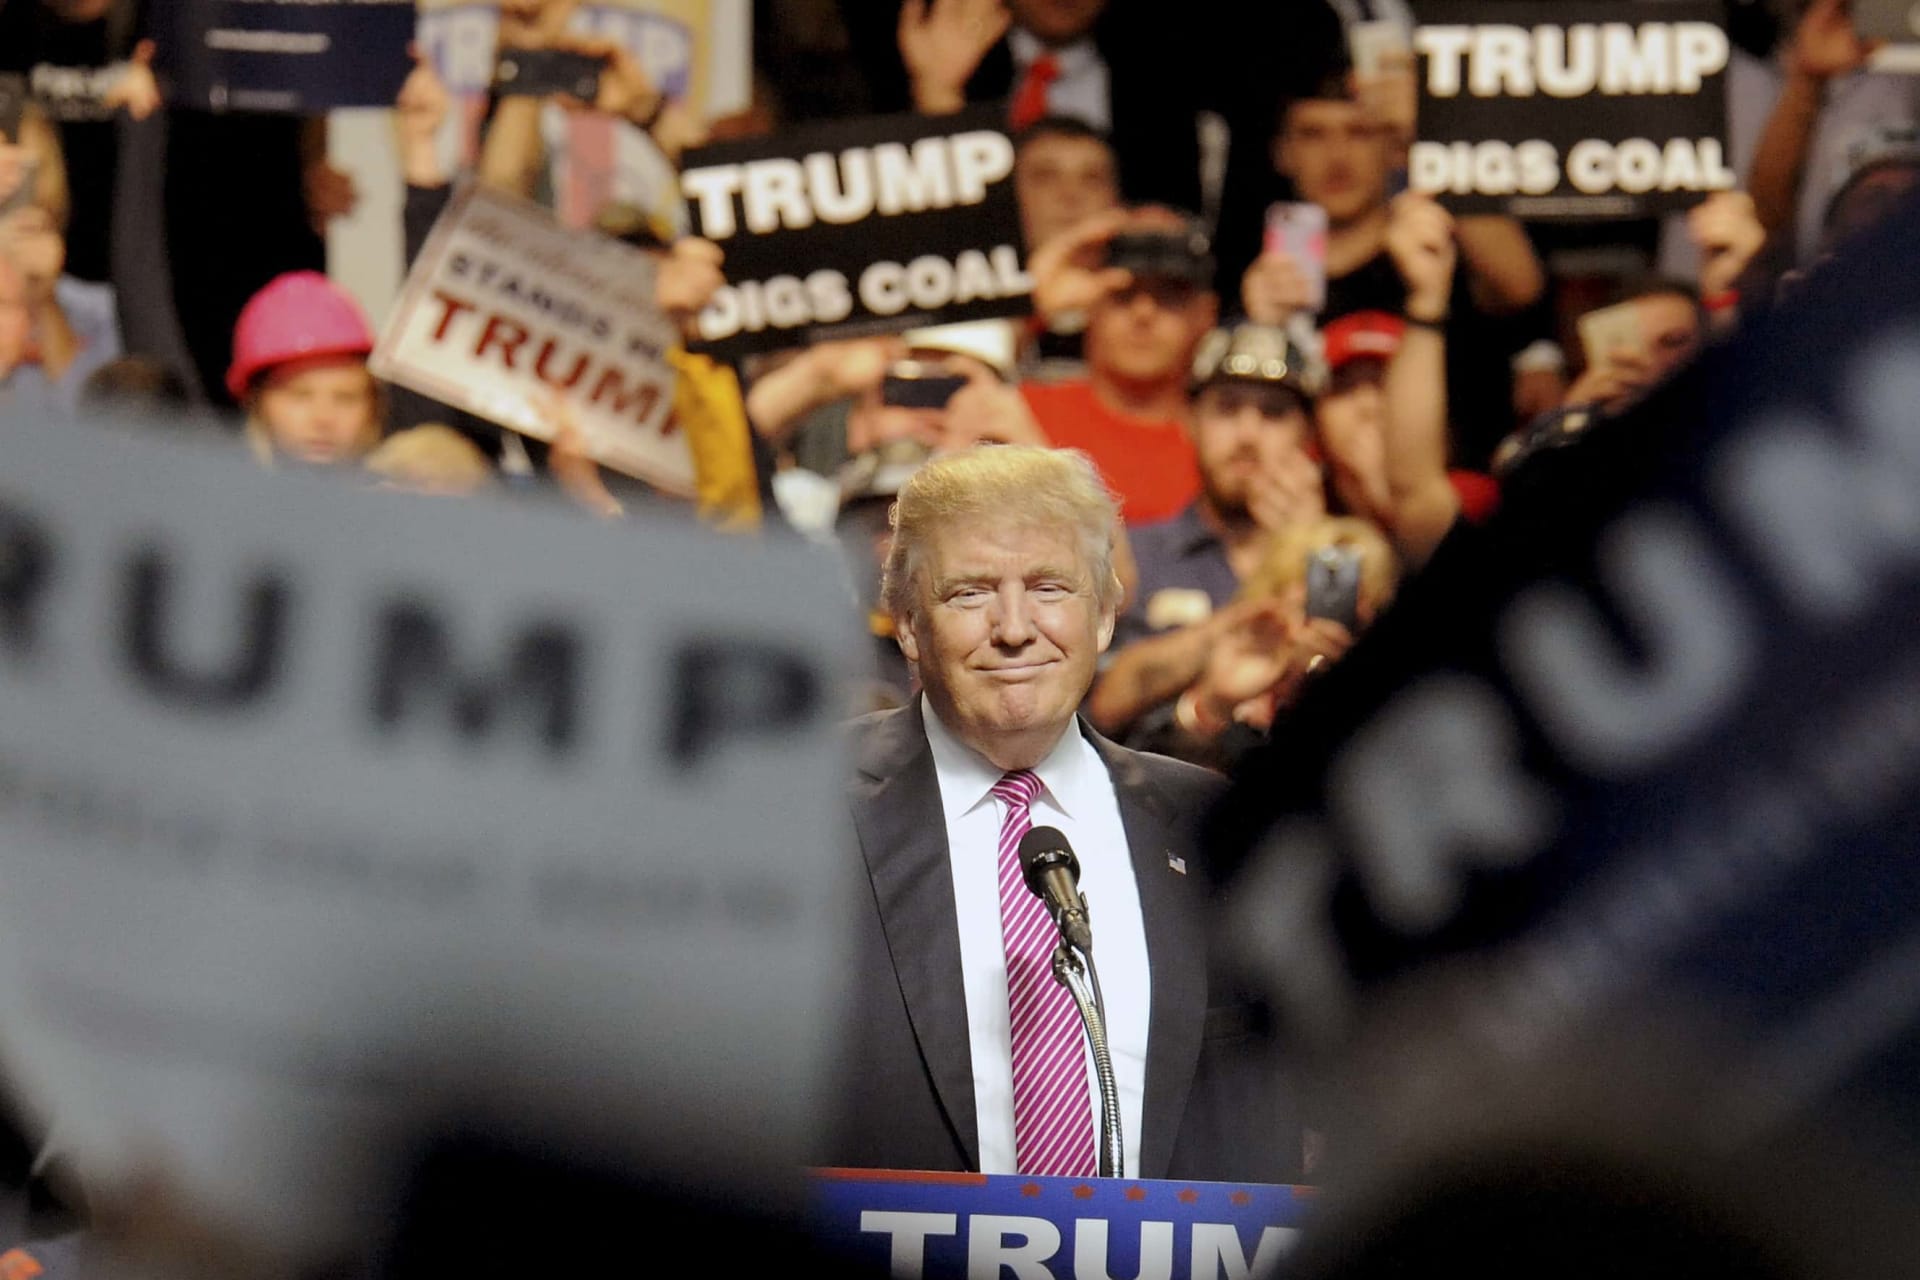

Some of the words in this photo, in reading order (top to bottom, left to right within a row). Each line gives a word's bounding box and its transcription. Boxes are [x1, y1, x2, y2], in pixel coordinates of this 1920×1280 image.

[1413, 20, 1730, 98] TRUMP
[680, 129, 1016, 240] TRUMP
[1409, 138, 1560, 195] DIGS
[1566, 136, 1737, 194] COAL
[858, 244, 1038, 316] COAL
